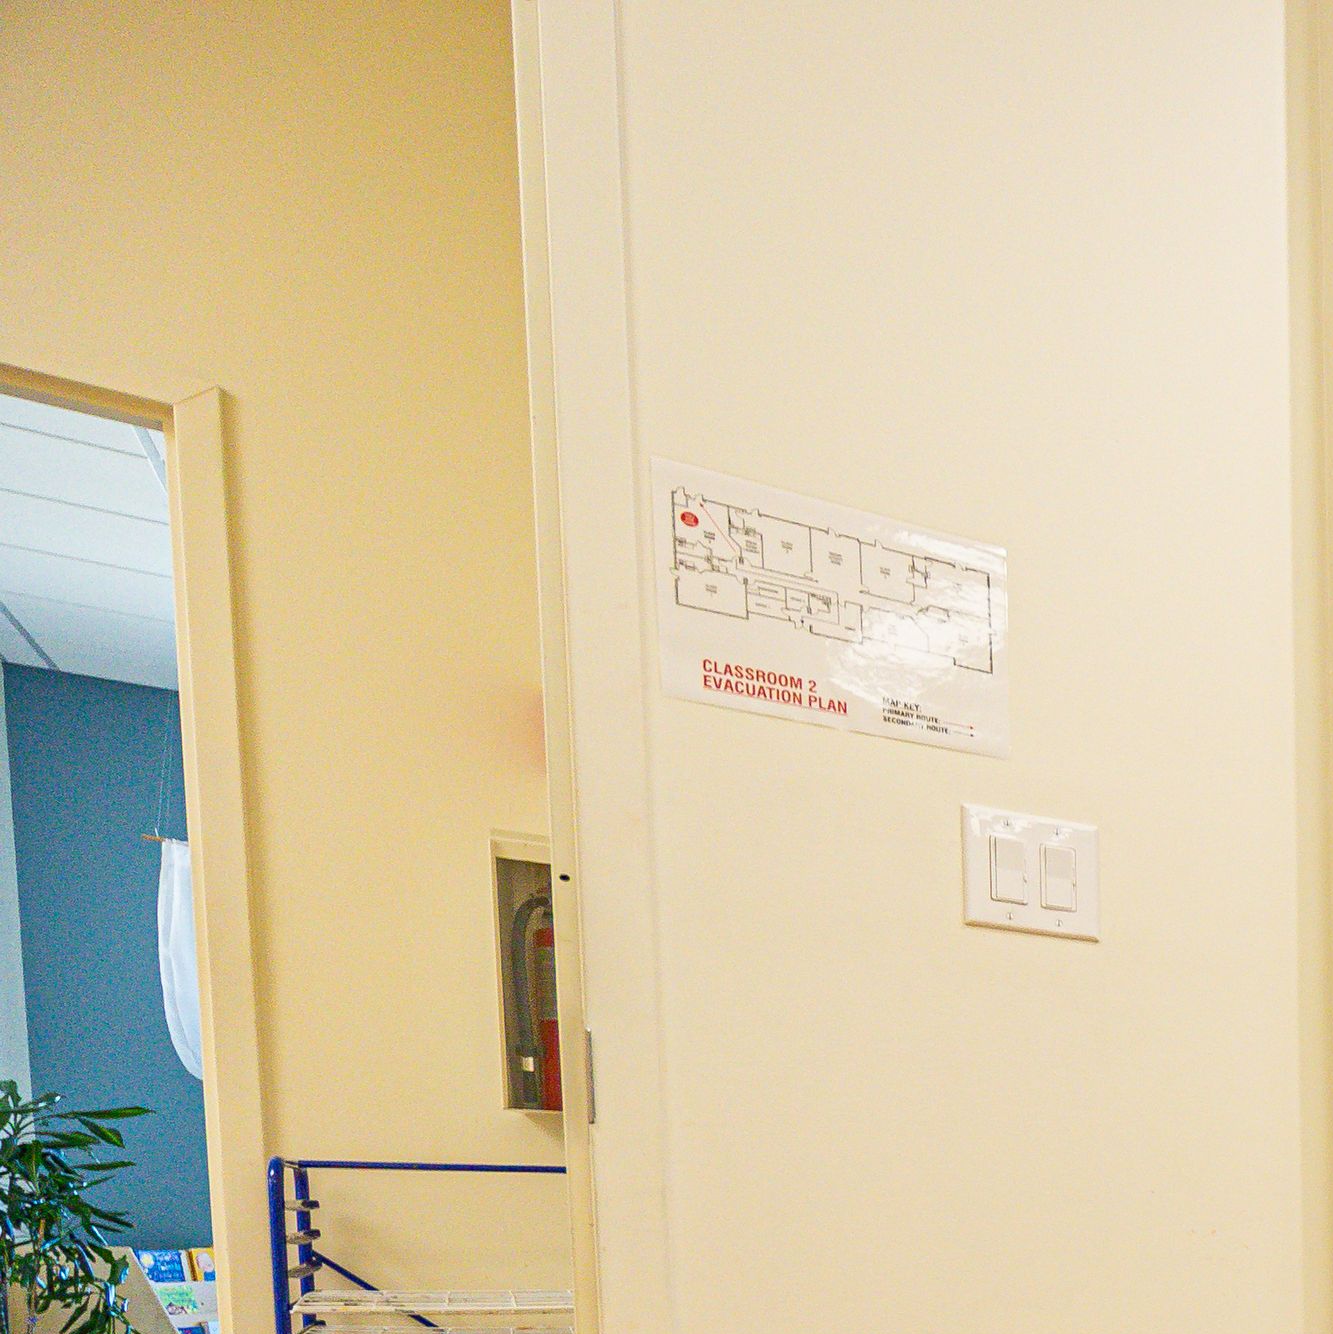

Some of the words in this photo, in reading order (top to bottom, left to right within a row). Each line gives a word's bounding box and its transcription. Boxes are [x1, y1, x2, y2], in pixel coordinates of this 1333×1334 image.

[702, 658, 803, 690] CLASSROOM
[808, 679, 818, 693] 2
[703, 675, 802, 706] EVACUATION
[808, 694, 848, 714] PLAN
[882, 715, 924, 730] SECOND
